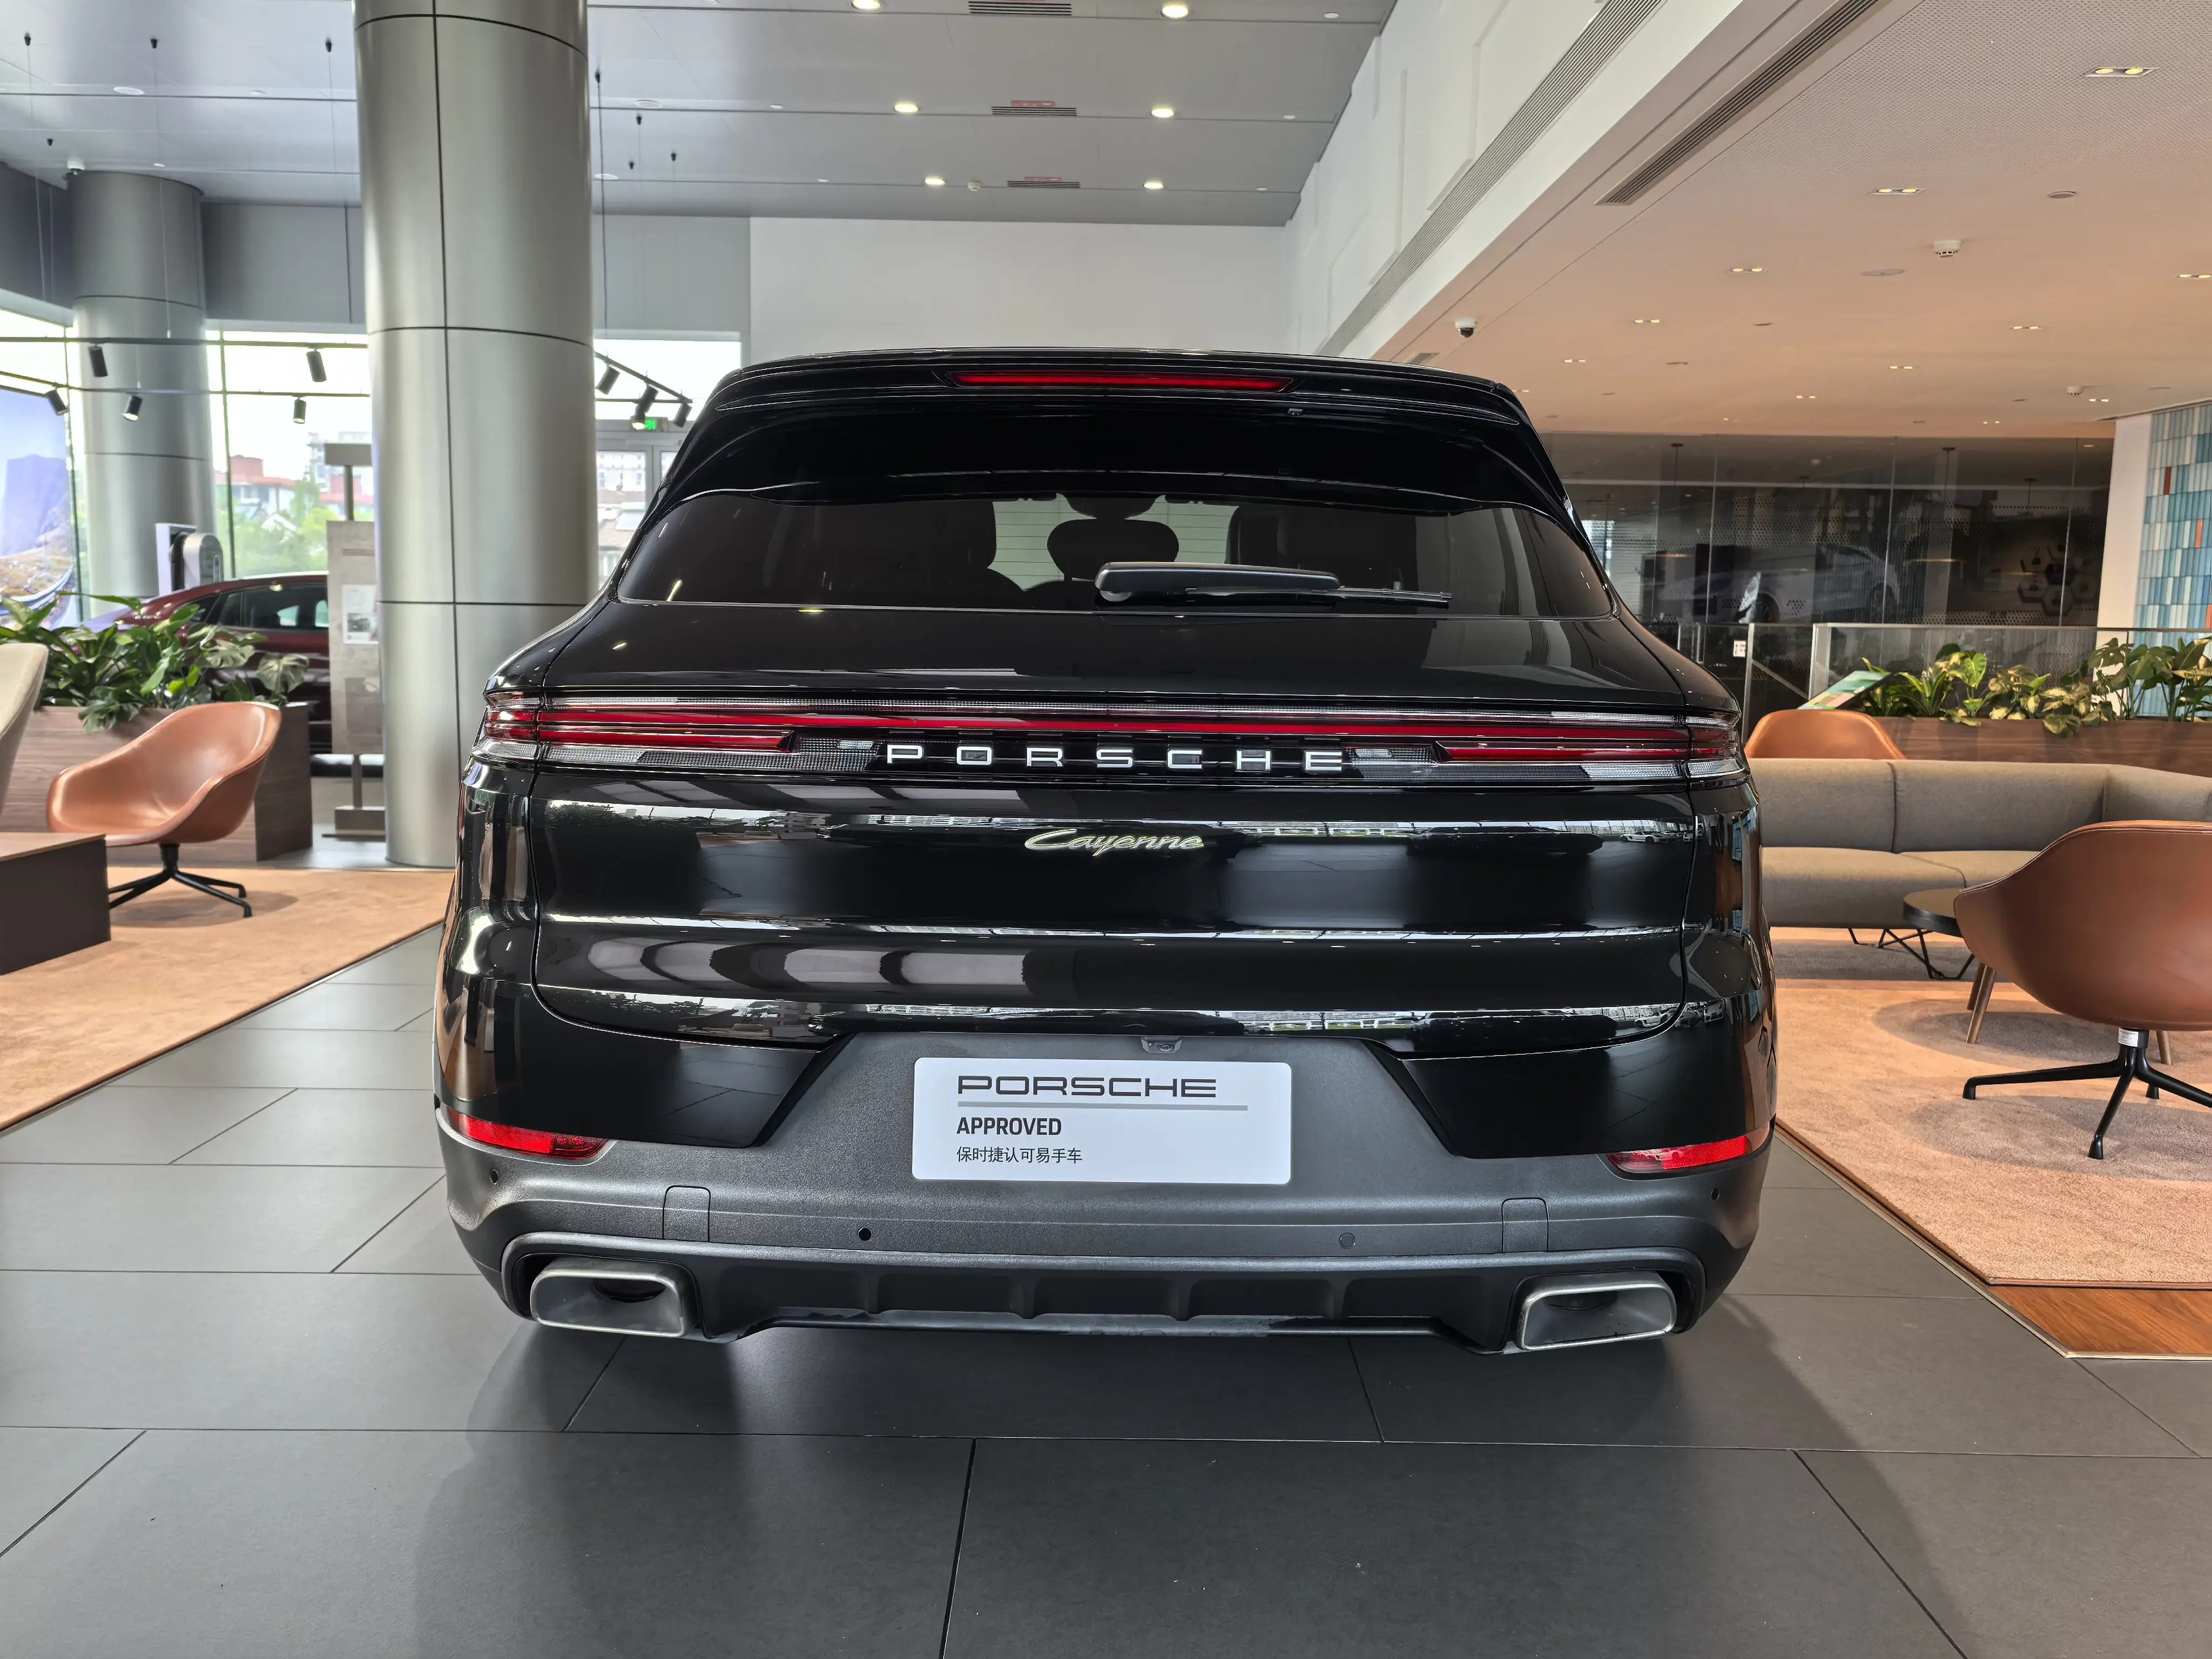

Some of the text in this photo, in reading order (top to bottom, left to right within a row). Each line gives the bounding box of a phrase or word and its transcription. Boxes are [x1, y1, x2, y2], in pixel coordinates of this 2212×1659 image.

[887, 744, 1343, 772] PORSCHE
[1024, 828, 1204, 857] Cayenne
[957, 1075, 1216, 1098] PORSCHE
[956, 1117, 1062, 1136] APPROVED
[956, 1146, 1083, 1164] 保时捷认可易手车
